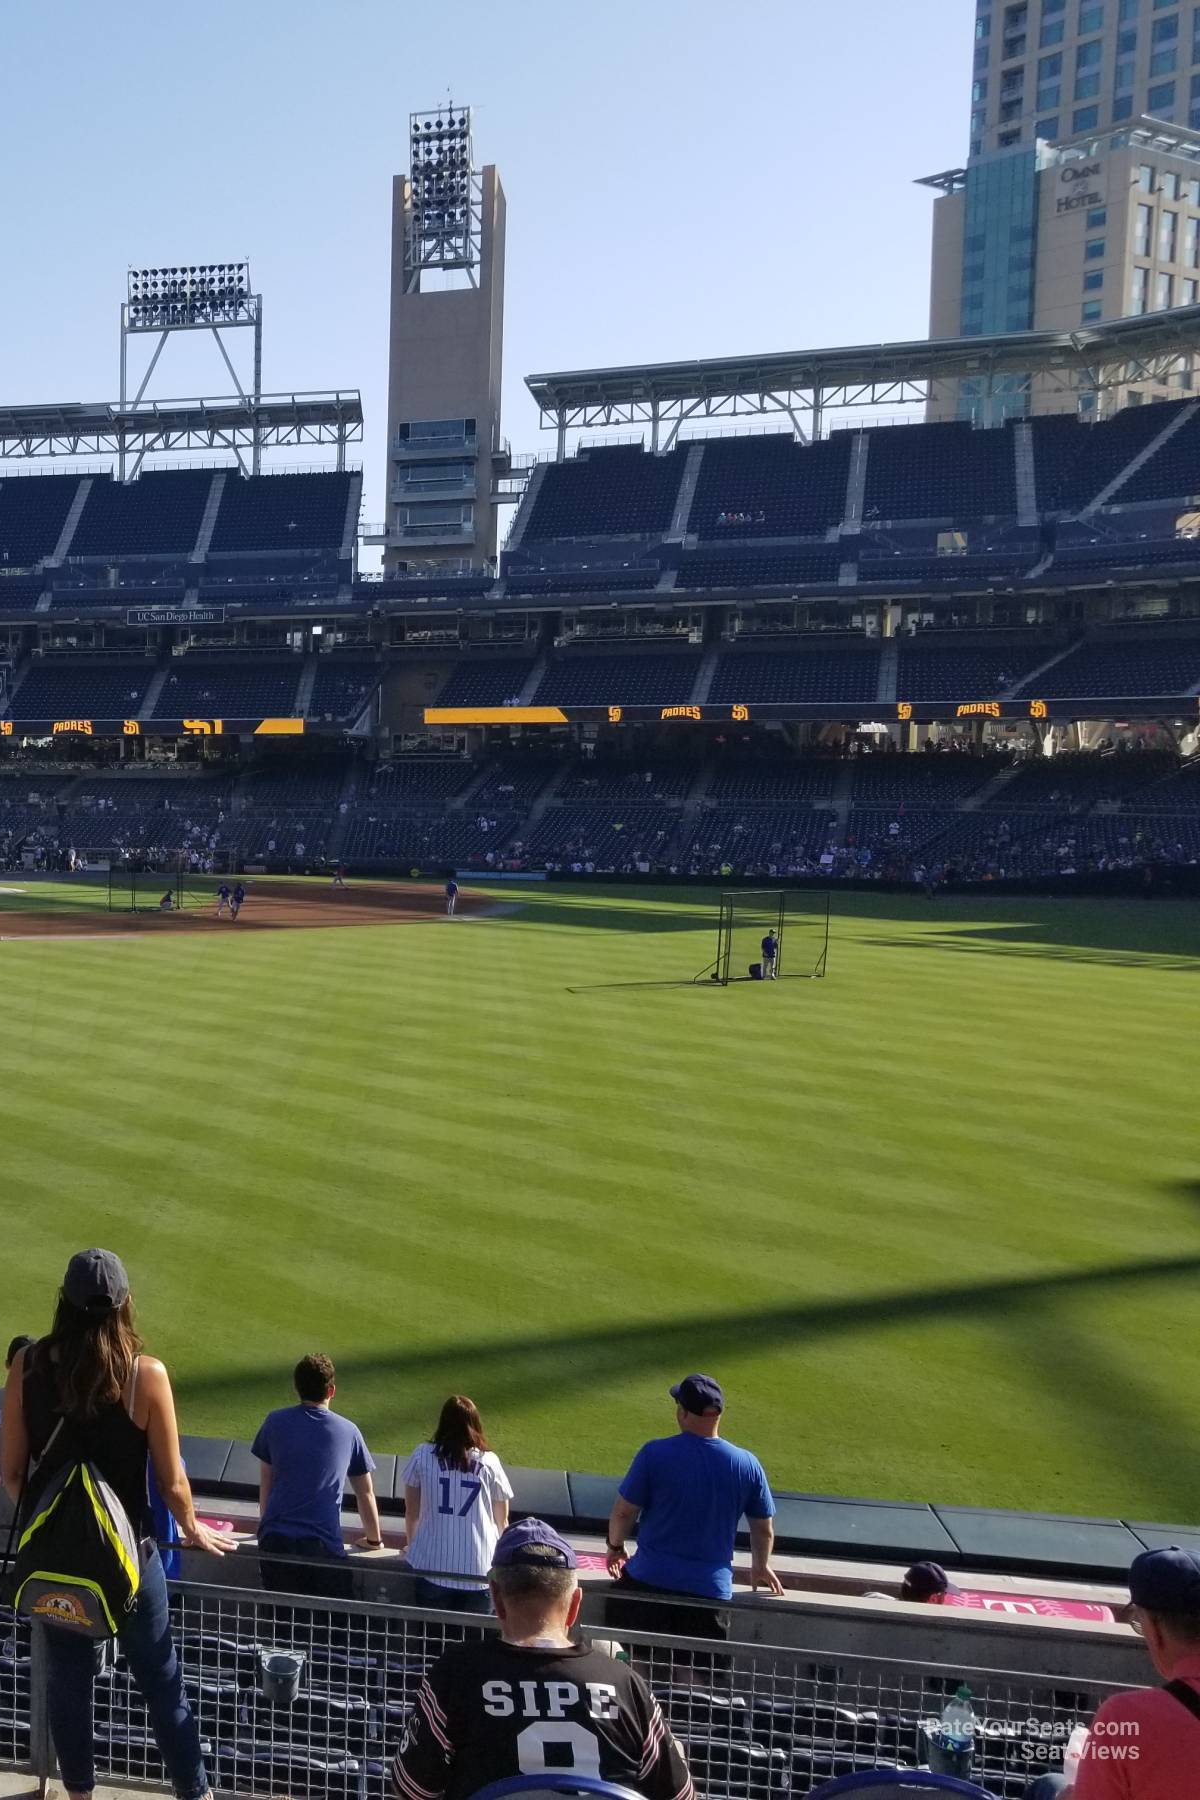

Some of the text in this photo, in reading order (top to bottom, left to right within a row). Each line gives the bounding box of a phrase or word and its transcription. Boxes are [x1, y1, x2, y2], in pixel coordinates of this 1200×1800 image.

[136, 611, 214, 623] UC San Diego Health
[661, 706, 702, 720] PADRES
[956, 702, 1000, 717] PADRES
[53, 720, 93, 735] PADRES
[438, 1477, 482, 1517] 17
[482, 1680, 619, 1719] SIPE
